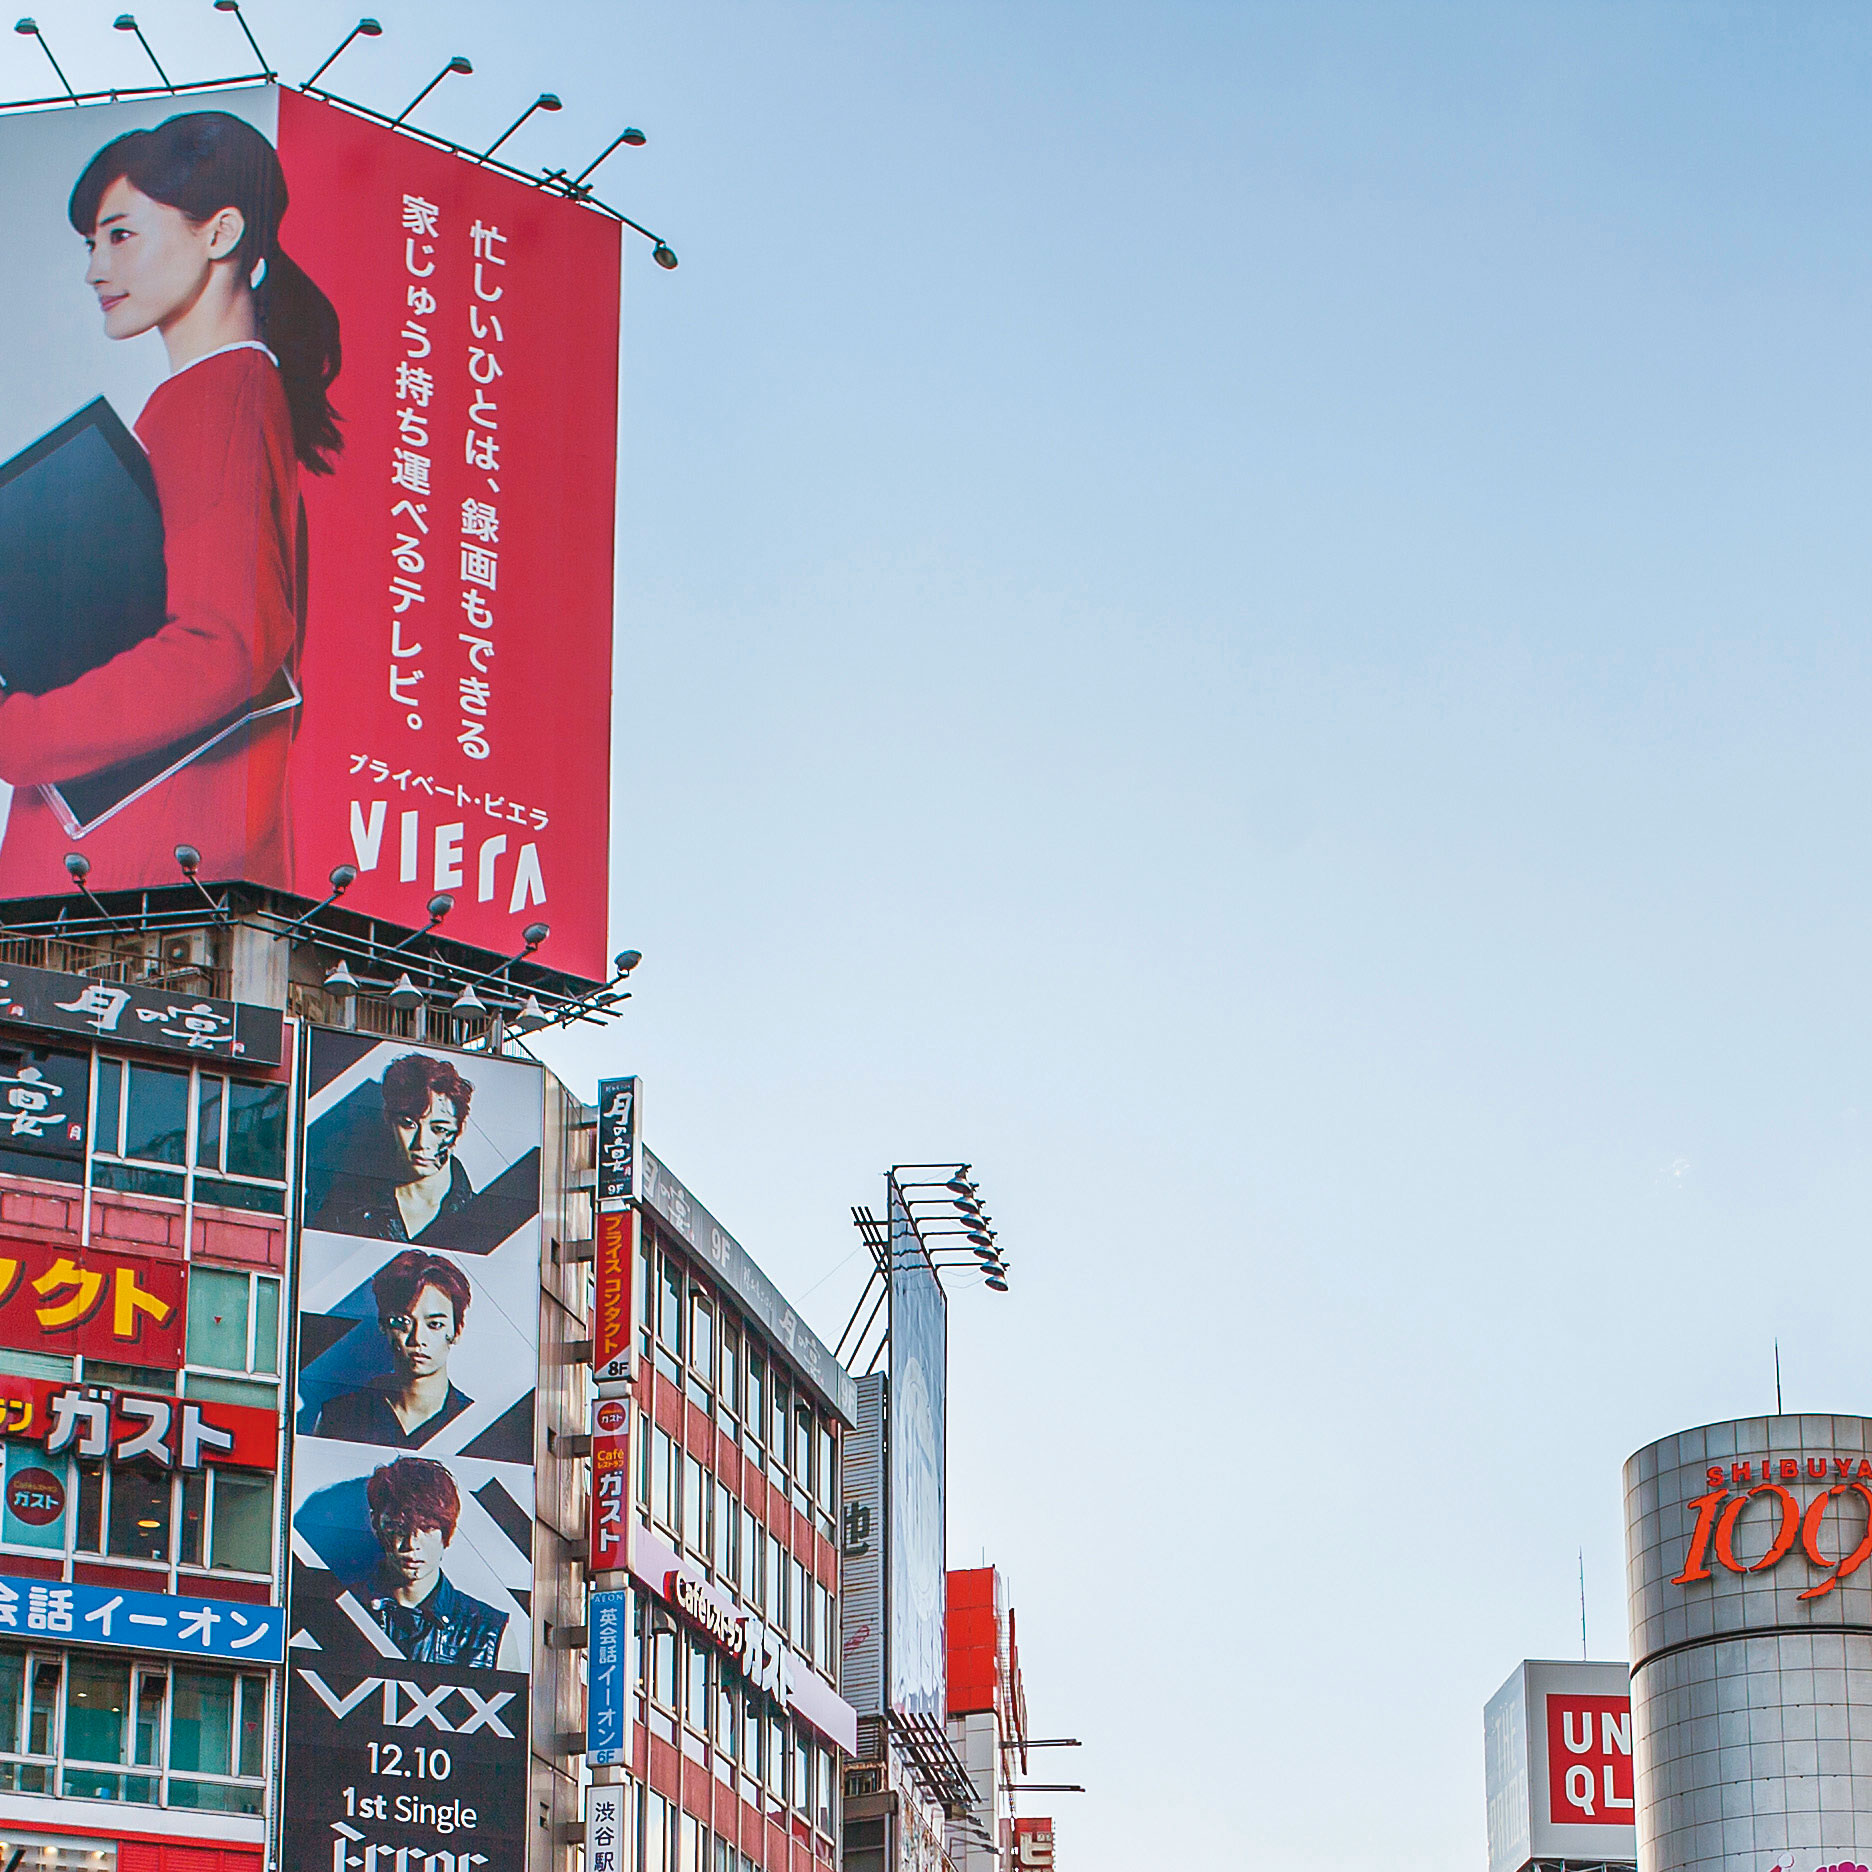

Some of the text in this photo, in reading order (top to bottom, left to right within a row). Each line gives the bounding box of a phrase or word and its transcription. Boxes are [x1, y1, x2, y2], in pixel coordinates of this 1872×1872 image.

[385, 193, 441, 733] 家じゅう持ち運べるテレビ。
[456, 219, 508, 762] 忙しいひとは、録画もできる
[347, 752, 552, 833] プライベート・ビエラ
[348, 800, 549, 912] VIERA
[54, 985, 232, 1051] 月の宴
[607, 1181, 625, 1196] 9F
[603, 1213, 624, 1355] プライス コンタクト
[709, 1233, 731, 1268] 9F
[607, 1360, 630, 1377] 8F
[46, 1387, 233, 1470] ガスト
[597, 1448, 626, 1462] Café
[14, 1491, 60, 1510] ガスト
[598, 1469, 625, 1554] ガスト
[595, 1607, 620, 1748] 英会話イーオン
[740, 1620, 796, 1709] ガスト
[297, 1667, 518, 1740] VIXX
[366, 1741, 453, 1781] 12.10
[596, 1748, 617, 1765] 6F
[342, 1787, 478, 1834] 1st Single
